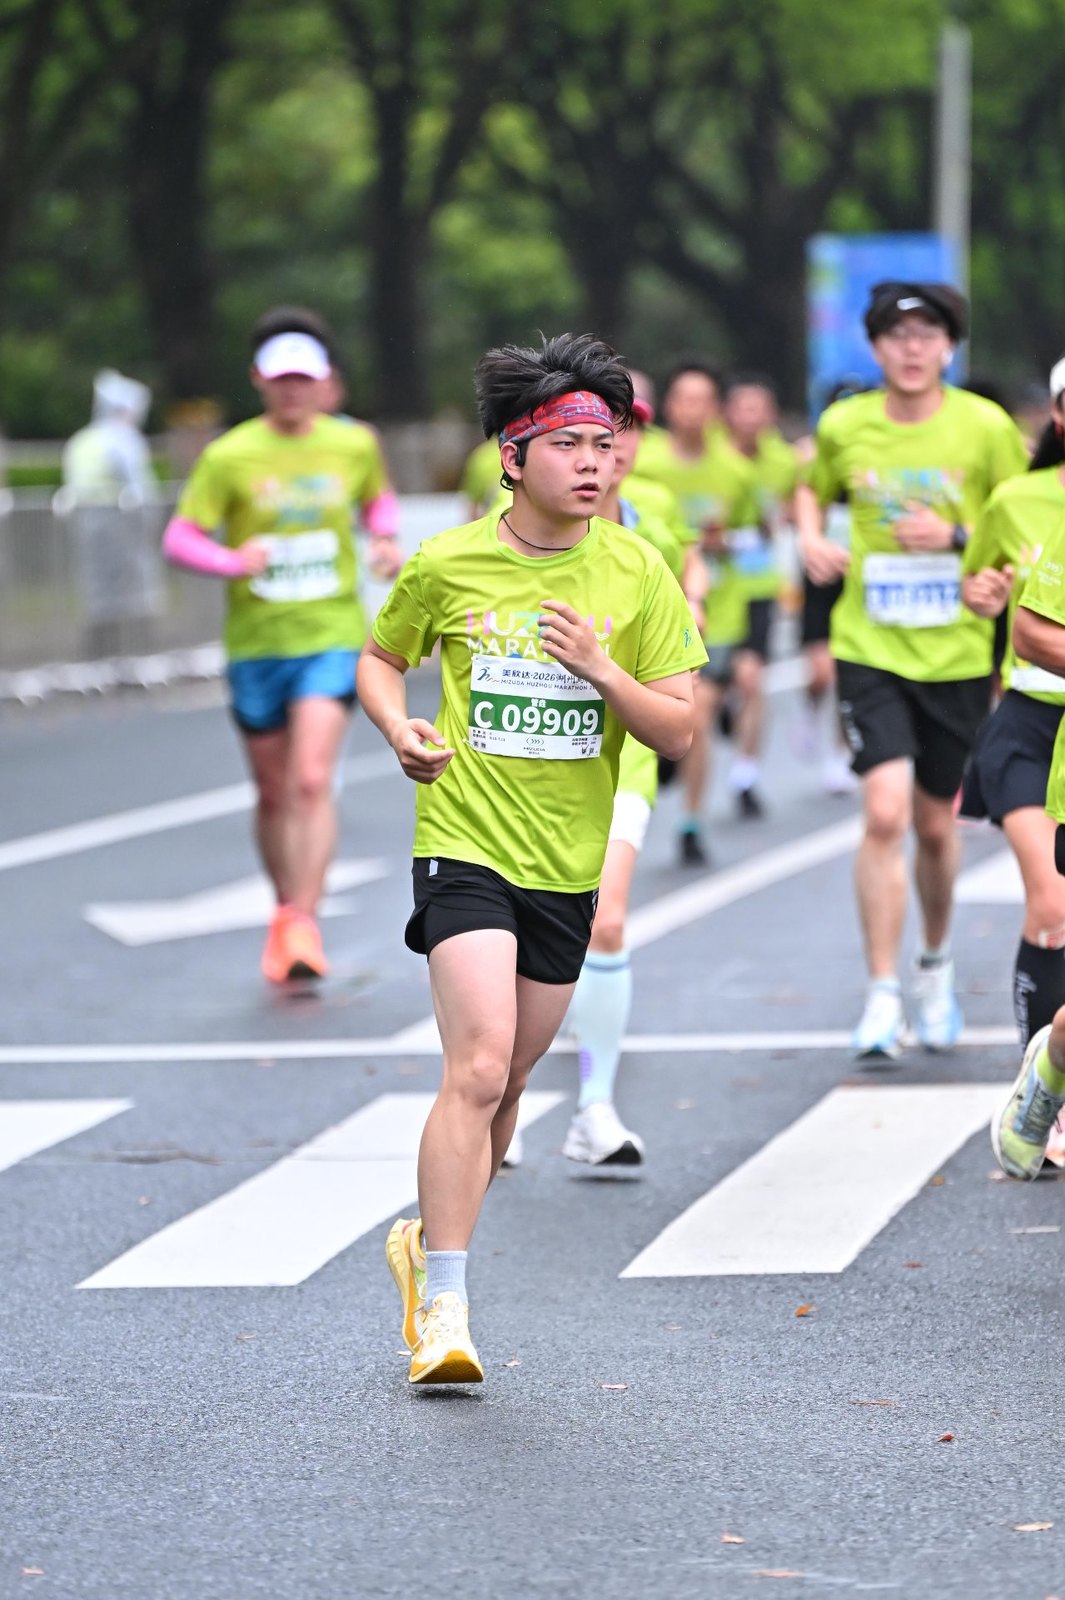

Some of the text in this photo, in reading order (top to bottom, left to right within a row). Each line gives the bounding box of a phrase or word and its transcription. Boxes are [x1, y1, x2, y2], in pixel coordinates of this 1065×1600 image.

[466, 609, 612, 641] HUZU
[474, 701, 599, 736] C 09909
